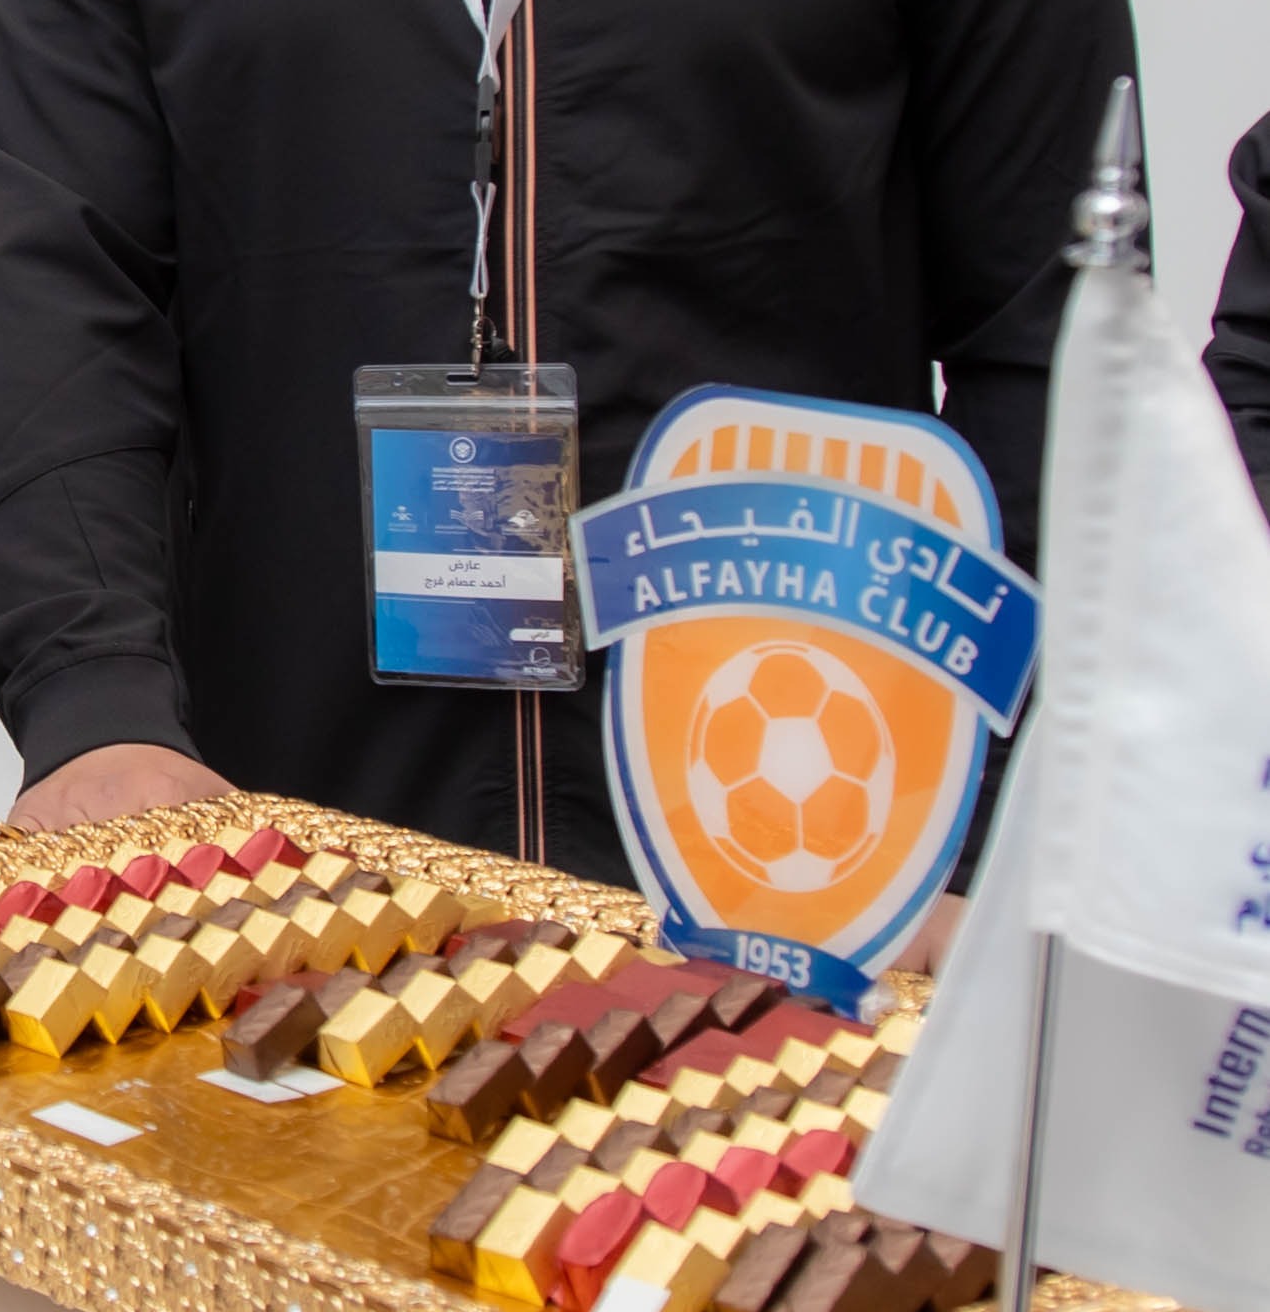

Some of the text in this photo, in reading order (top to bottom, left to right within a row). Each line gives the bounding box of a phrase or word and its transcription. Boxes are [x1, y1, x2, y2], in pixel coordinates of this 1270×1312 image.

[624, 496, 859, 558] الفيحاء
[449, 560, 480, 572] عارض
[634, 559, 980, 676] ALFAYHA CLUB
[737, 935, 812, 988] 1953
